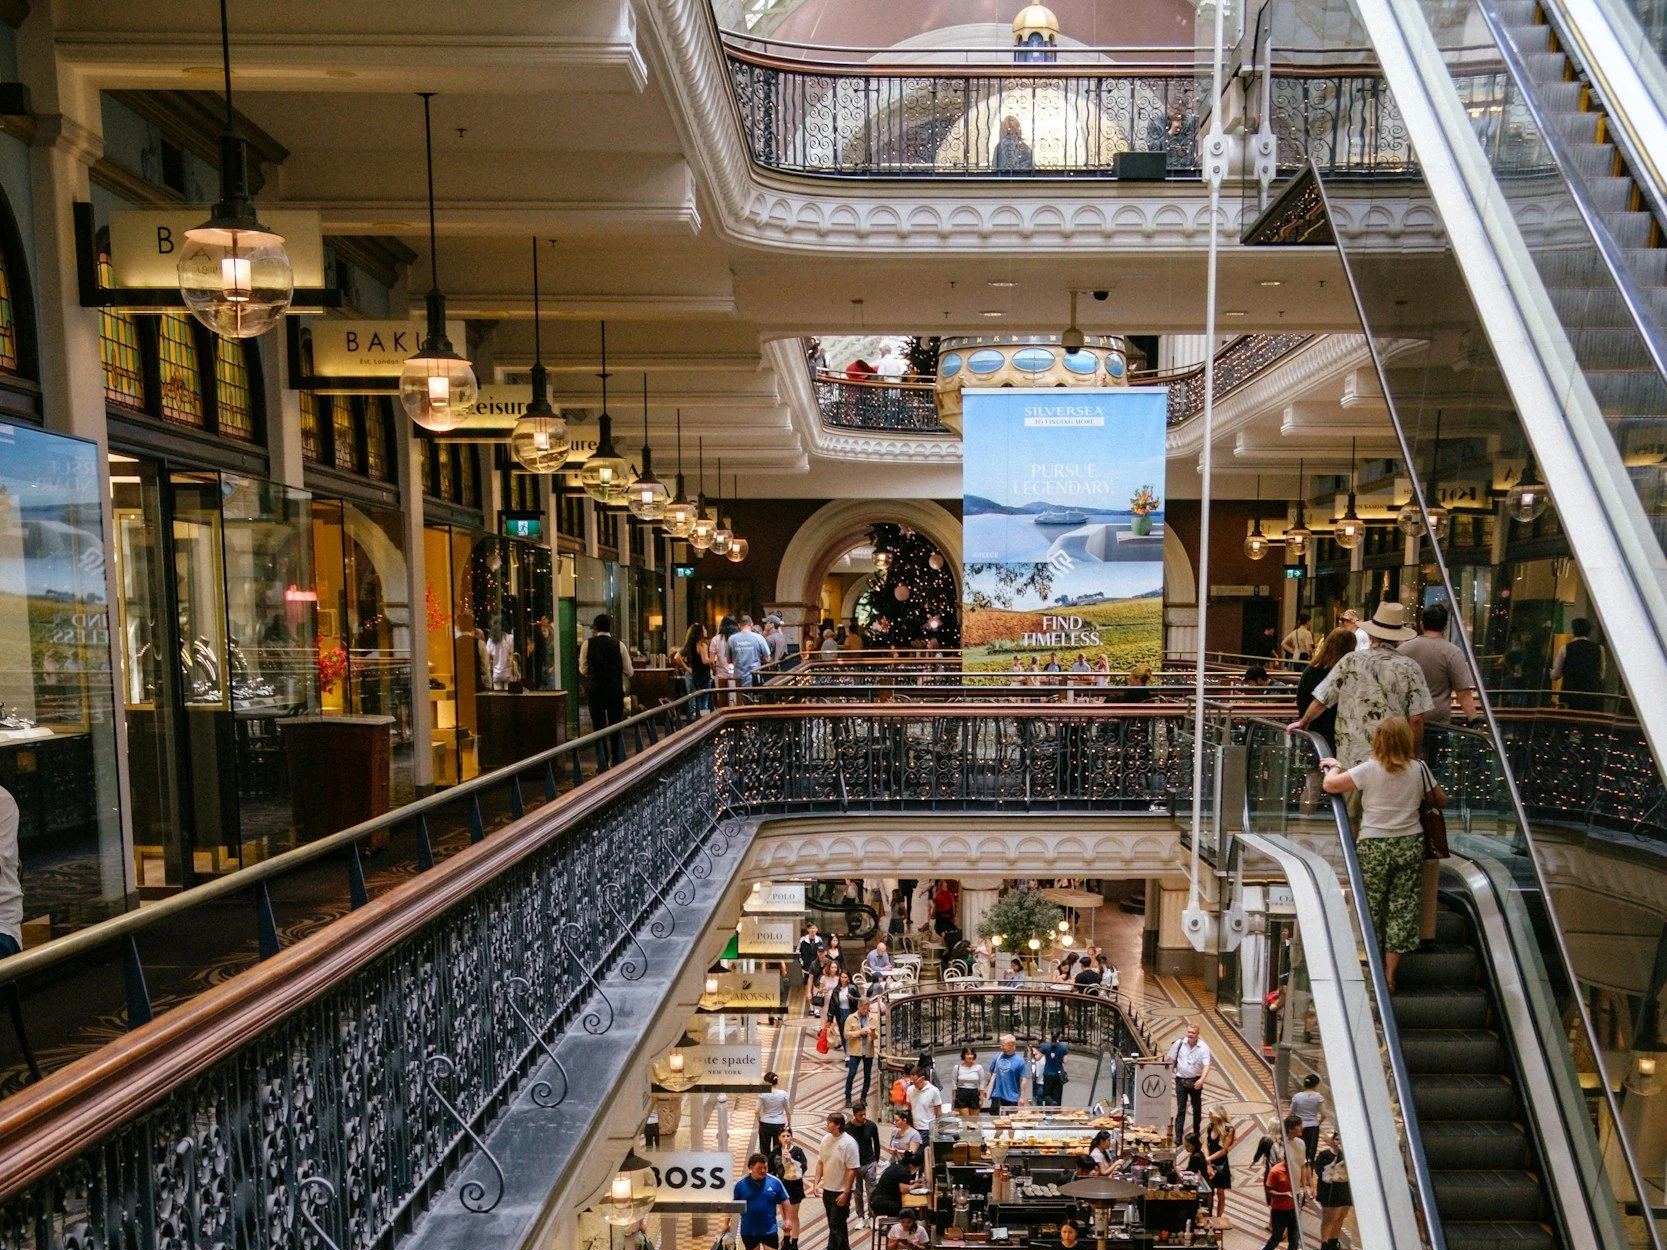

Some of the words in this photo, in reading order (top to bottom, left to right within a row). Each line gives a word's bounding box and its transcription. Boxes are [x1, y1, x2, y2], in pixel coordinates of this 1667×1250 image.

[1024, 406, 1104, 416] SILVERSEA
[1031, 463, 1097, 478] PURSUE
[1042, 616, 1082, 630] FIND
[1021, 631, 1104, 647] TIMELESS.
[757, 932, 783, 940] POLO
[722, 1054, 757, 1067] spade
